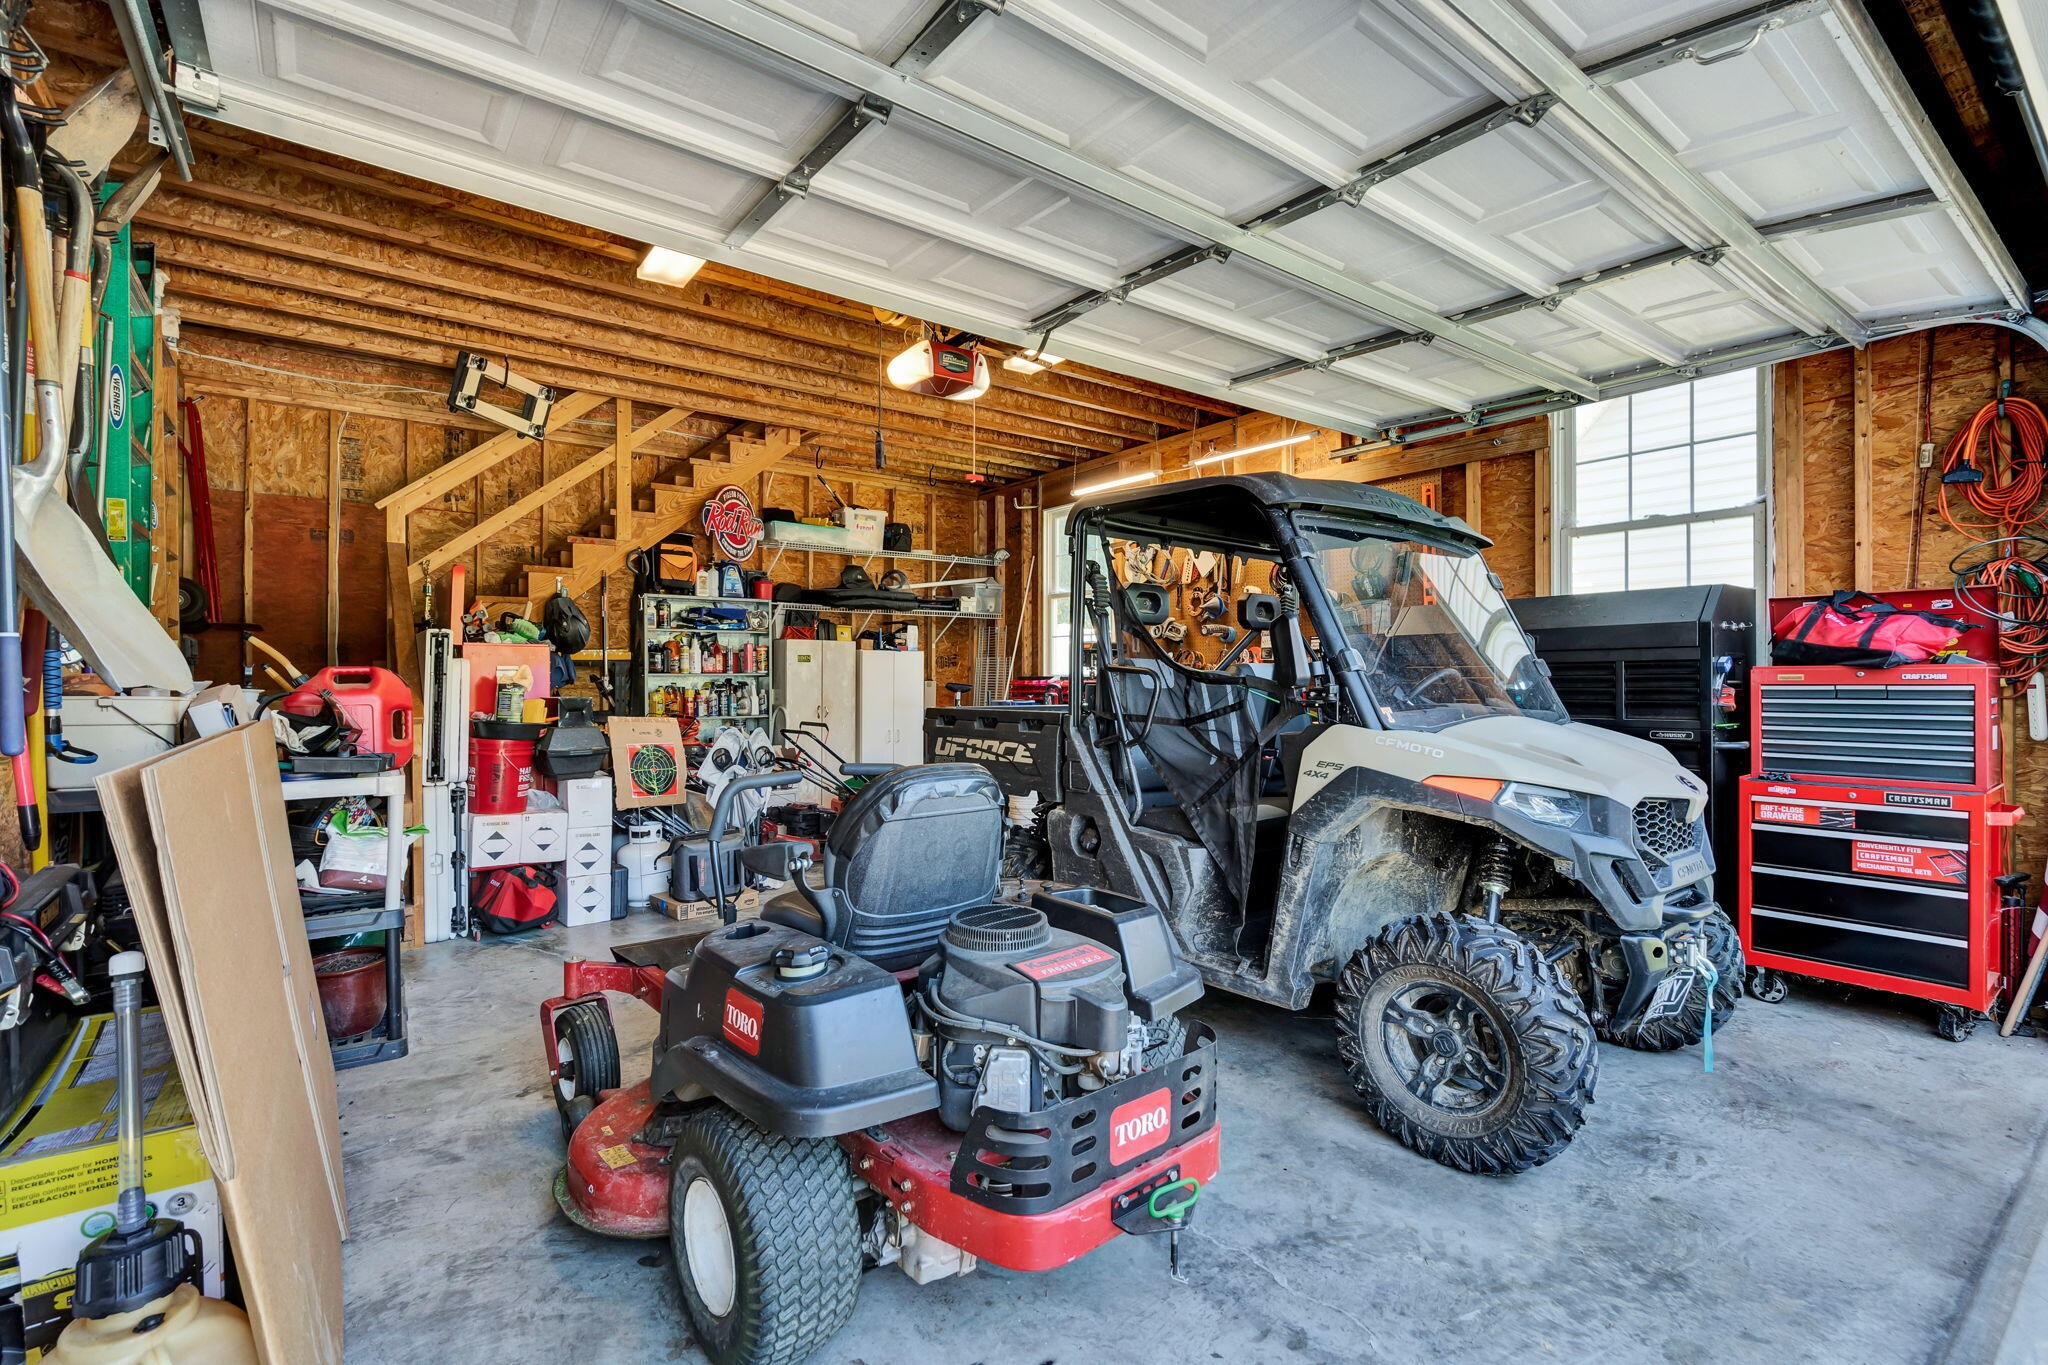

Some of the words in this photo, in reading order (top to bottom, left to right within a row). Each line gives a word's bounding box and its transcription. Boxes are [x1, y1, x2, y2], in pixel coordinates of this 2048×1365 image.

[112, 378, 121, 417] WERNER
[705, 500, 738, 540] Rod
[934, 737, 1037, 764] UFORCE
[1375, 735, 1445, 758] CFMOTO
[1316, 760, 1345, 771] EPS
[1303, 769, 1329, 780] 4X4
[1888, 795, 1948, 806] CRAFTSMAN
[1760, 804, 1804, 814] SOFT-CLOSE
[1760, 811, 1804, 821] DRAWERS
[1857, 841, 1906, 852] CONVENIENTLY
[1860, 852, 1911, 863] CRAFTSMAN
[1857, 862, 1896, 872] MECHANICS
[727, 1004, 758, 1039] TORO
[1114, 1106, 1167, 1147] TORO
[11, 1171, 56, 1185] Dependable
[57, 1165, 80, 1175] power
[11, 1173, 75, 1192] RECREATION
[42, 1184, 76, 1195] confiable
[78, 1179, 95, 1188] para
[12, 1190, 77, 1210] RECREACIÓN
[177, 1197, 185, 1206] 3
